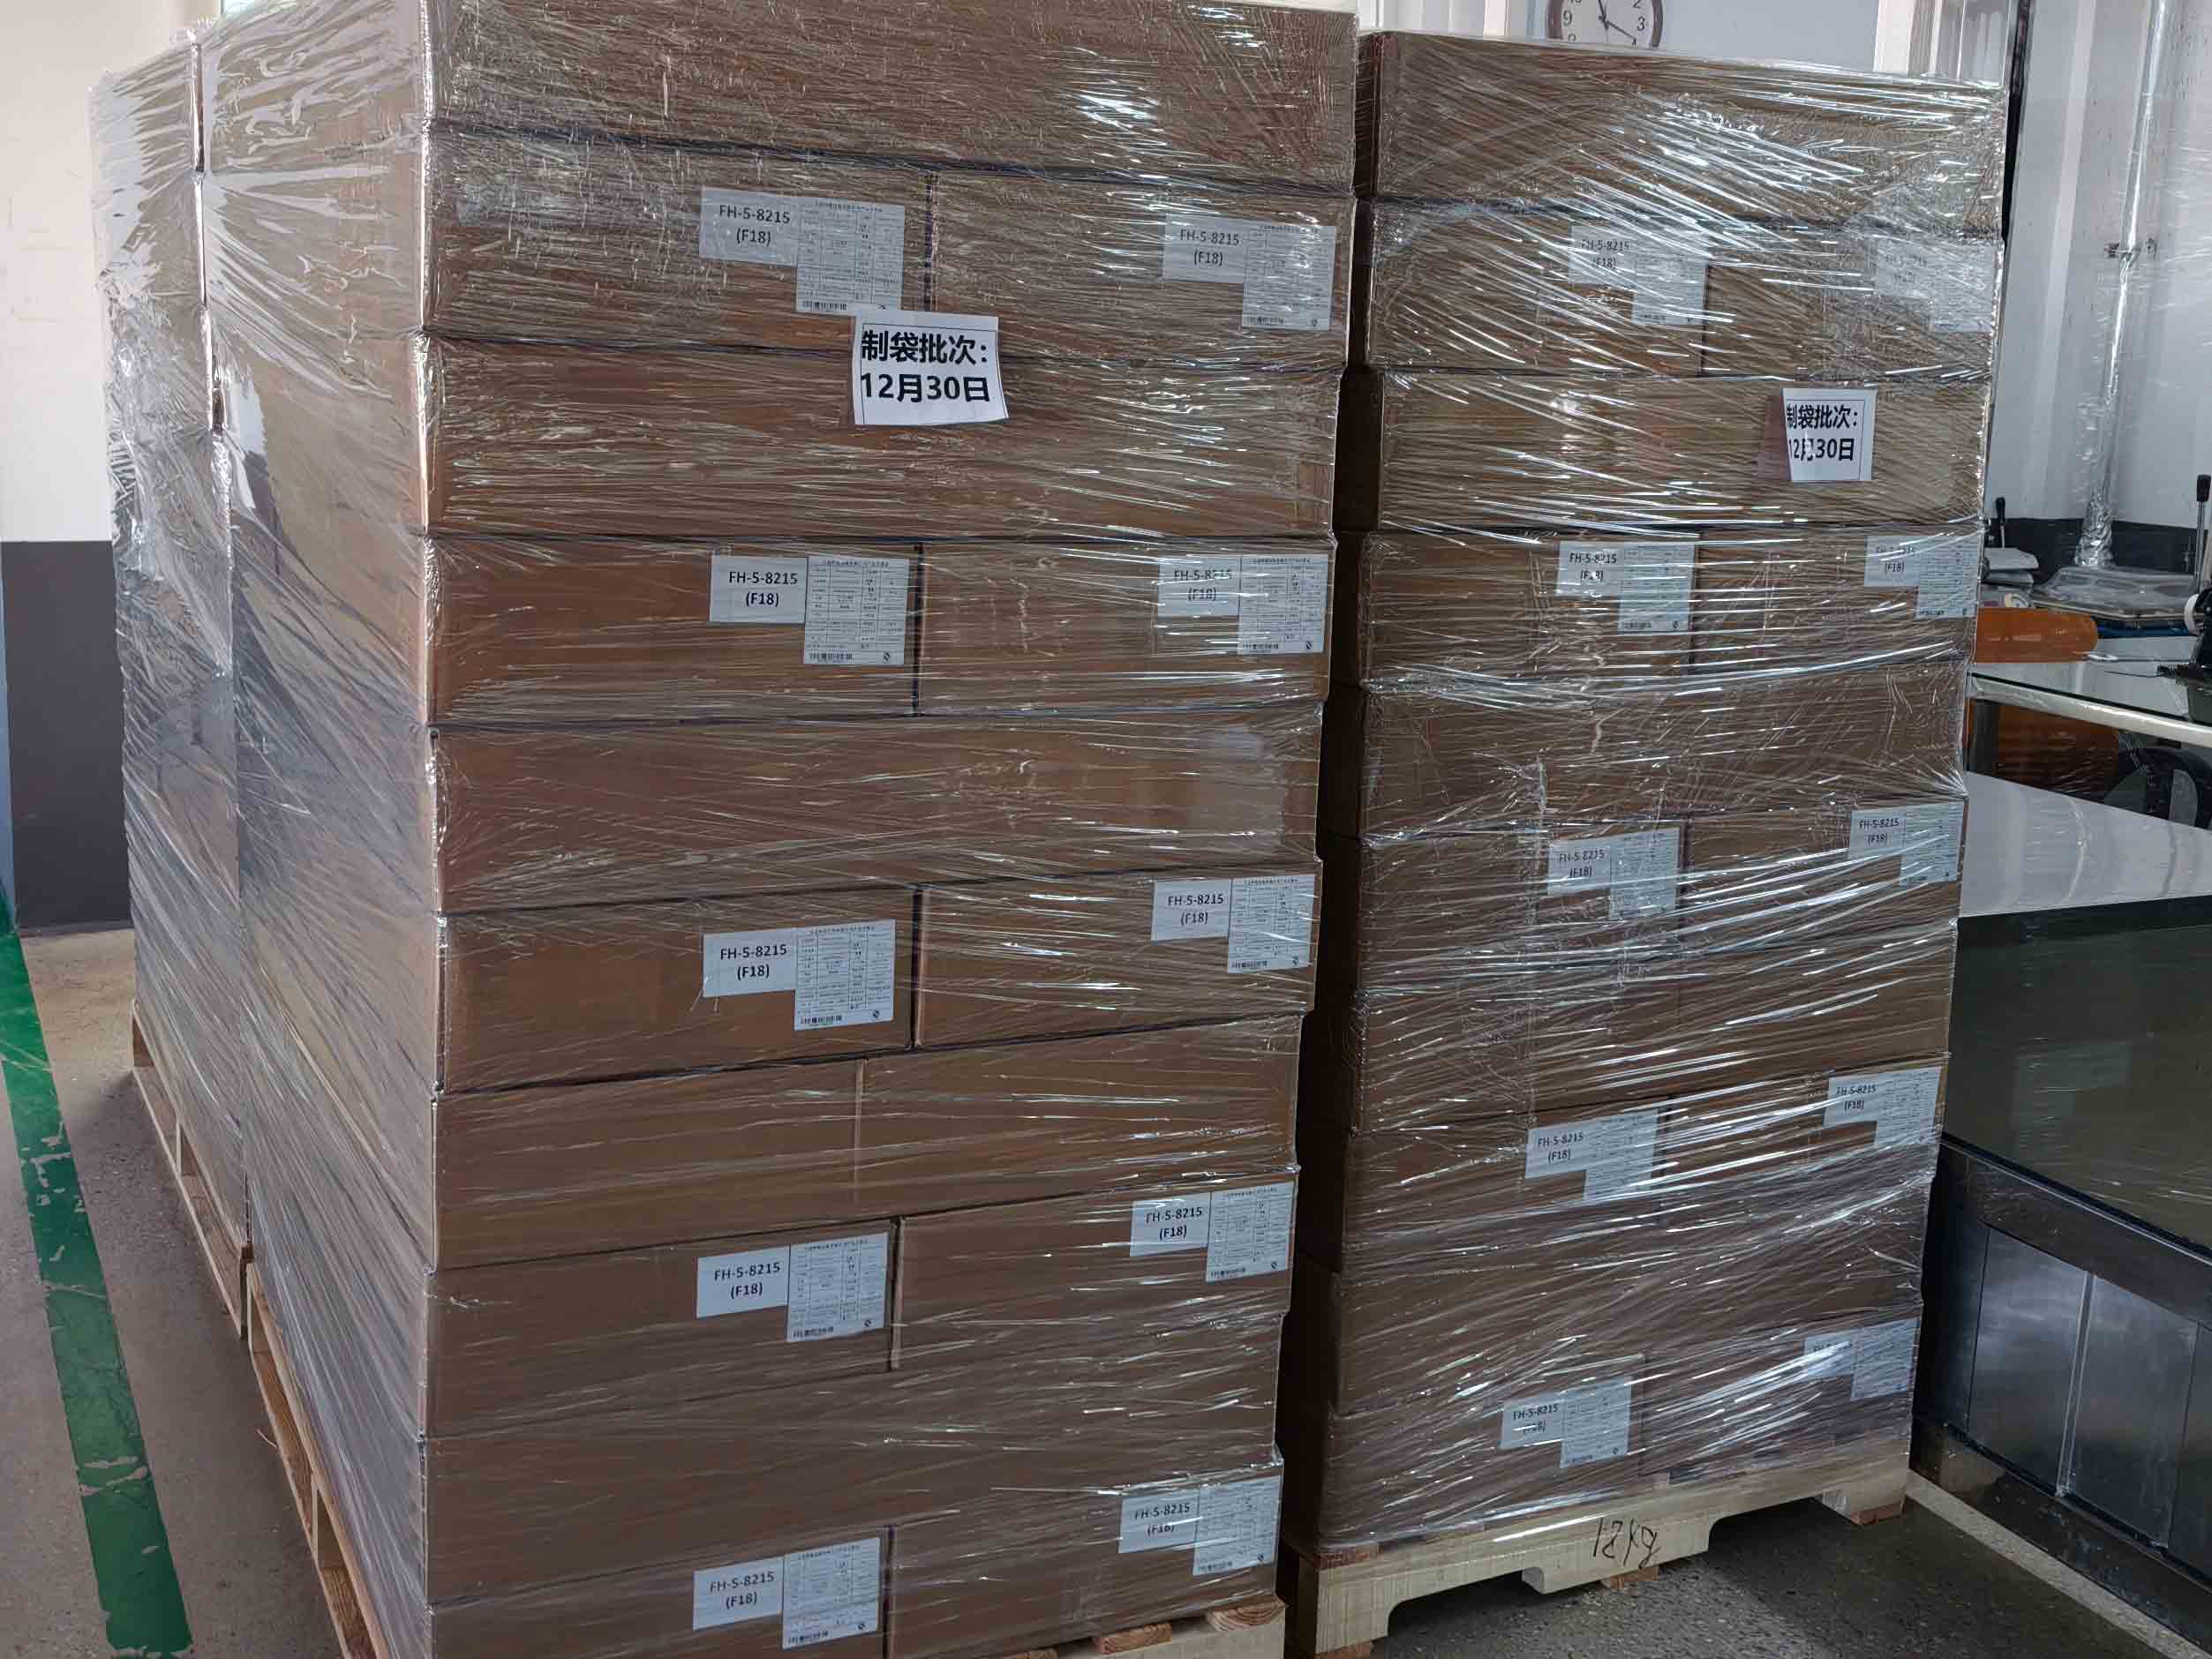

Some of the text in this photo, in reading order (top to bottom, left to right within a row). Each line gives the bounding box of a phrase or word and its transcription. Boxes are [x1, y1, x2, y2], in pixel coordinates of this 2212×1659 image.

[1563, 10, 1572, 26] 9
[1637, 16, 1645, 31] 3
[719, 204, 791, 224] FH-5-8215
[736, 229, 771, 246] (F18)
[1179, 229, 1239, 245] FH-5-8215
[1193, 251, 1223, 266] (F18)
[861, 372, 990, 402] 12月30日
[728, 571, 798, 585] FH-5-8215
[745, 592, 779, 608] (F18)
[1167, 893, 1223, 906] FH-5-8215
[1181, 912, 1208, 926] (F18)
[719, 944, 788, 960] FH-5-8215
[736, 965, 770, 980] (F18)
[1538, 1132, 1584, 1147] FH-5-8215
[1548, 1150, 1571, 1164] (F18)
[1146, 1206, 1202, 1225] FH-5-8215
[1159, 1226, 1187, 1242] (F18)
[714, 1261, 780, 1281] FH-5-8215
[730, 1282, 763, 1299] (F18)
[1134, 1503, 1190, 1520] FH-5-8215
[709, 1571, 775, 1594] FH-5-8215
[726, 1591, 757, 1610] (F18)
